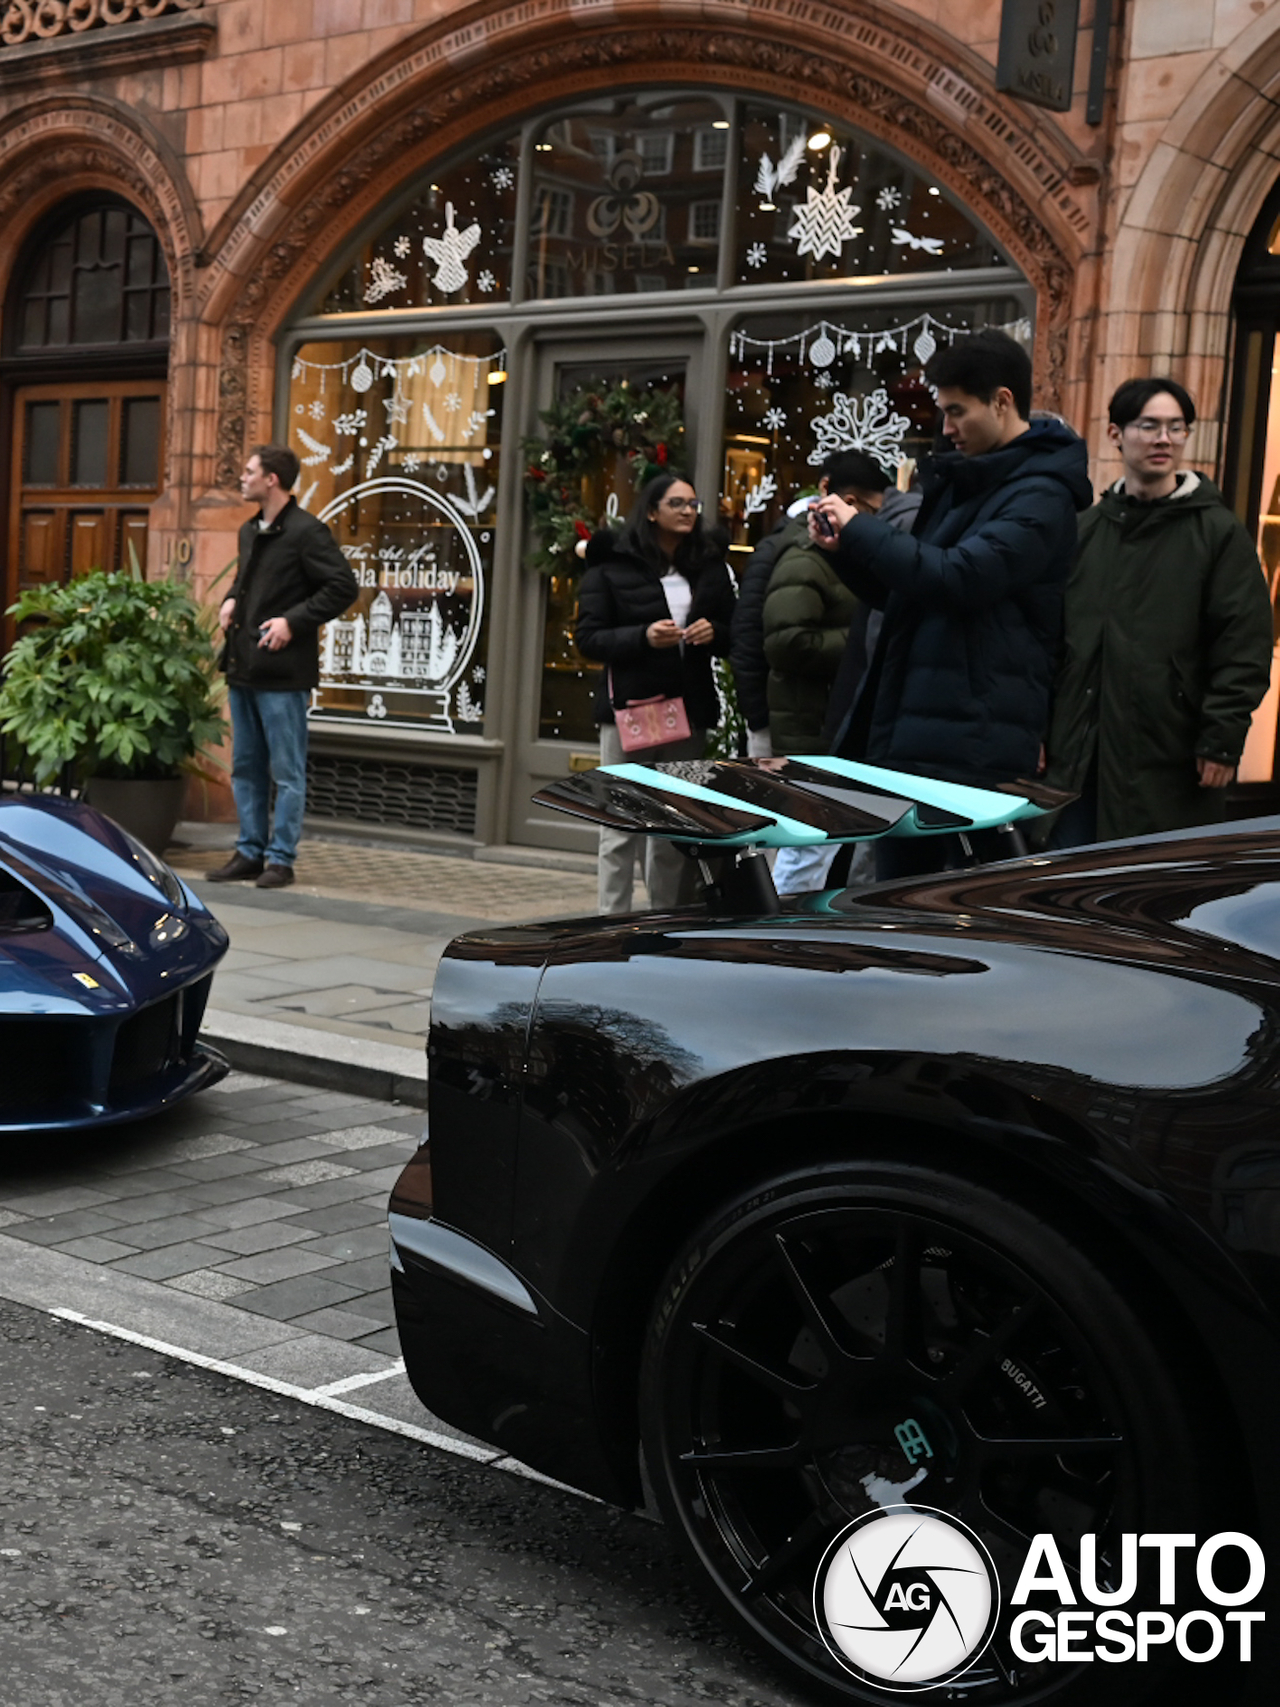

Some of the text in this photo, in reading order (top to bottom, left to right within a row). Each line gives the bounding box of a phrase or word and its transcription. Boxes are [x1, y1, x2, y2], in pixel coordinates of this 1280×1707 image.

[566, 242, 675, 272] MISELA
[340, 542, 372, 560] The
[382, 561, 460, 597] Holiday
[1000, 1358, 1048, 1410] BUGATTI
